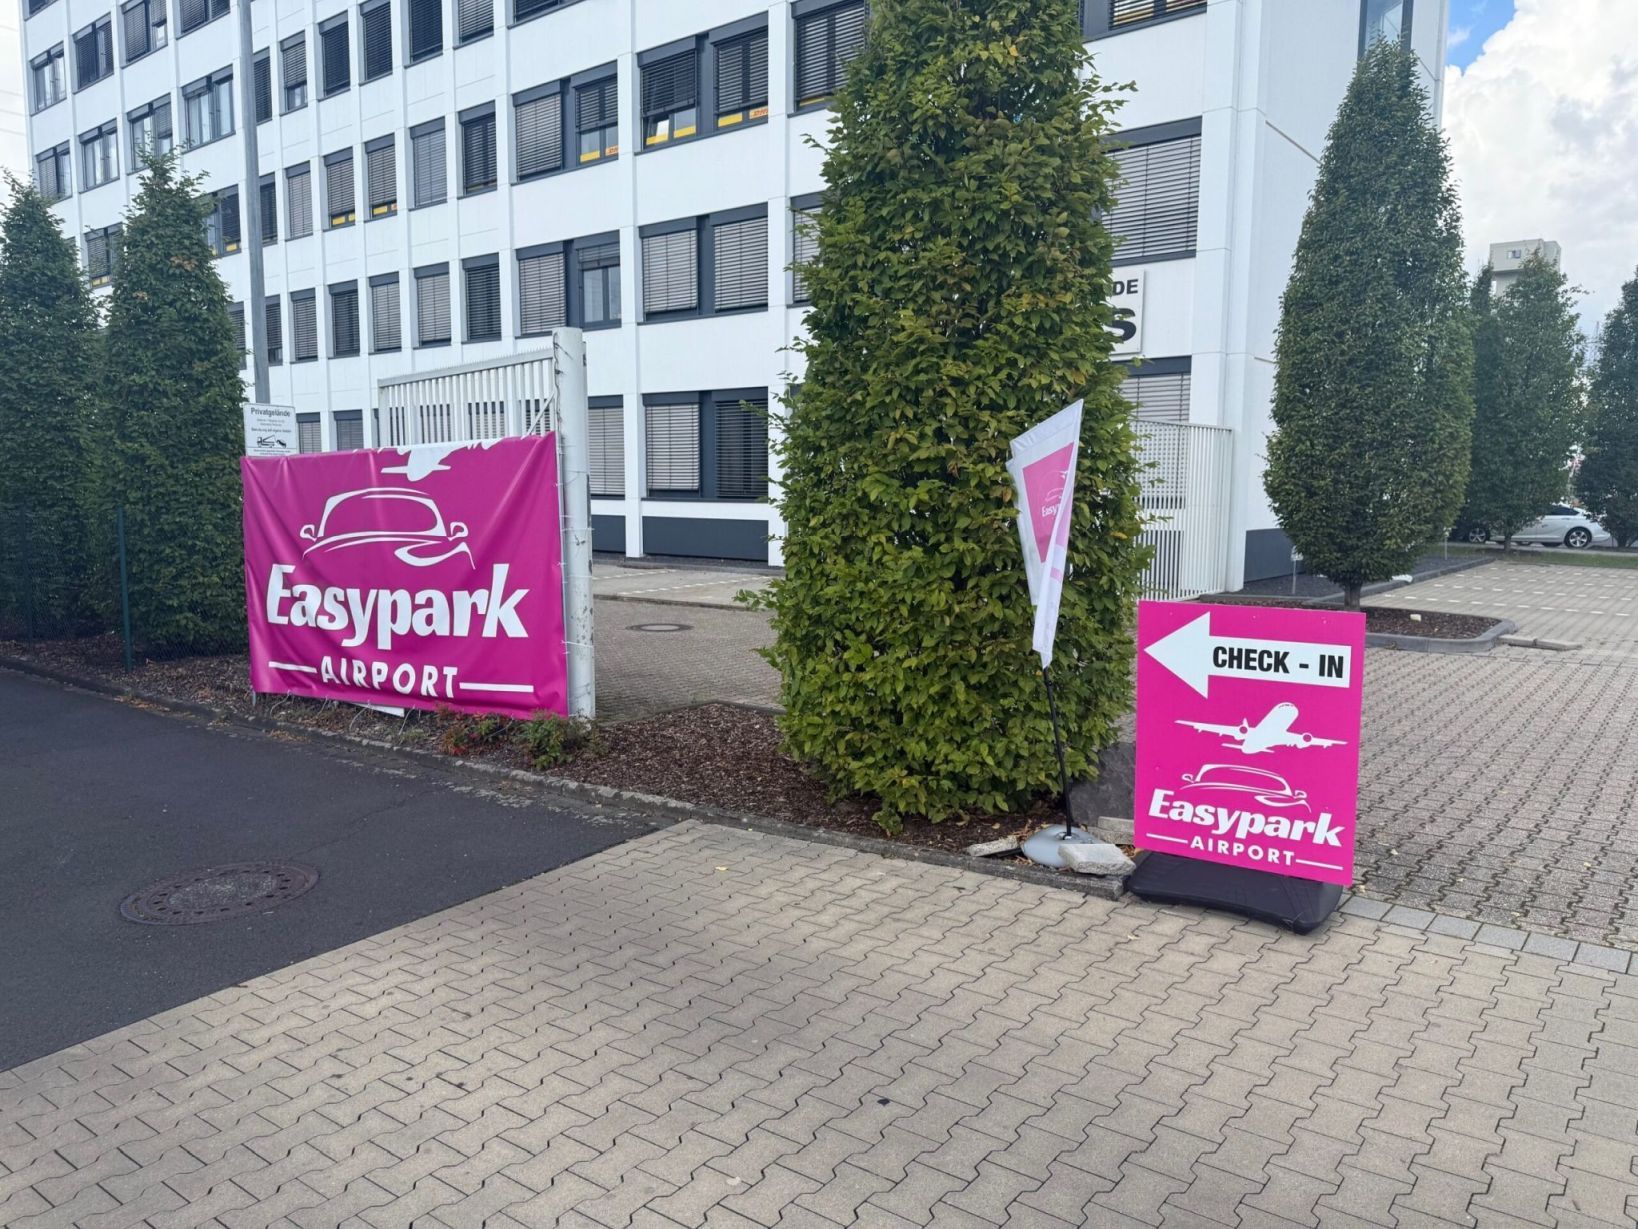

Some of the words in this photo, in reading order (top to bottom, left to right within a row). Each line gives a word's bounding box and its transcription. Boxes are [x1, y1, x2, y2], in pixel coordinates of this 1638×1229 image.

[250, 407, 291, 417] Privatgelände
[266, 563, 530, 650] Easypark
[320, 655, 458, 698] AIRPORT
[1212, 646, 1290, 674] CHECK
[1318, 654, 1344, 679] IN
[1148, 788, 1346, 847] Easypark
[1190, 835, 1296, 866] AIRPORT
